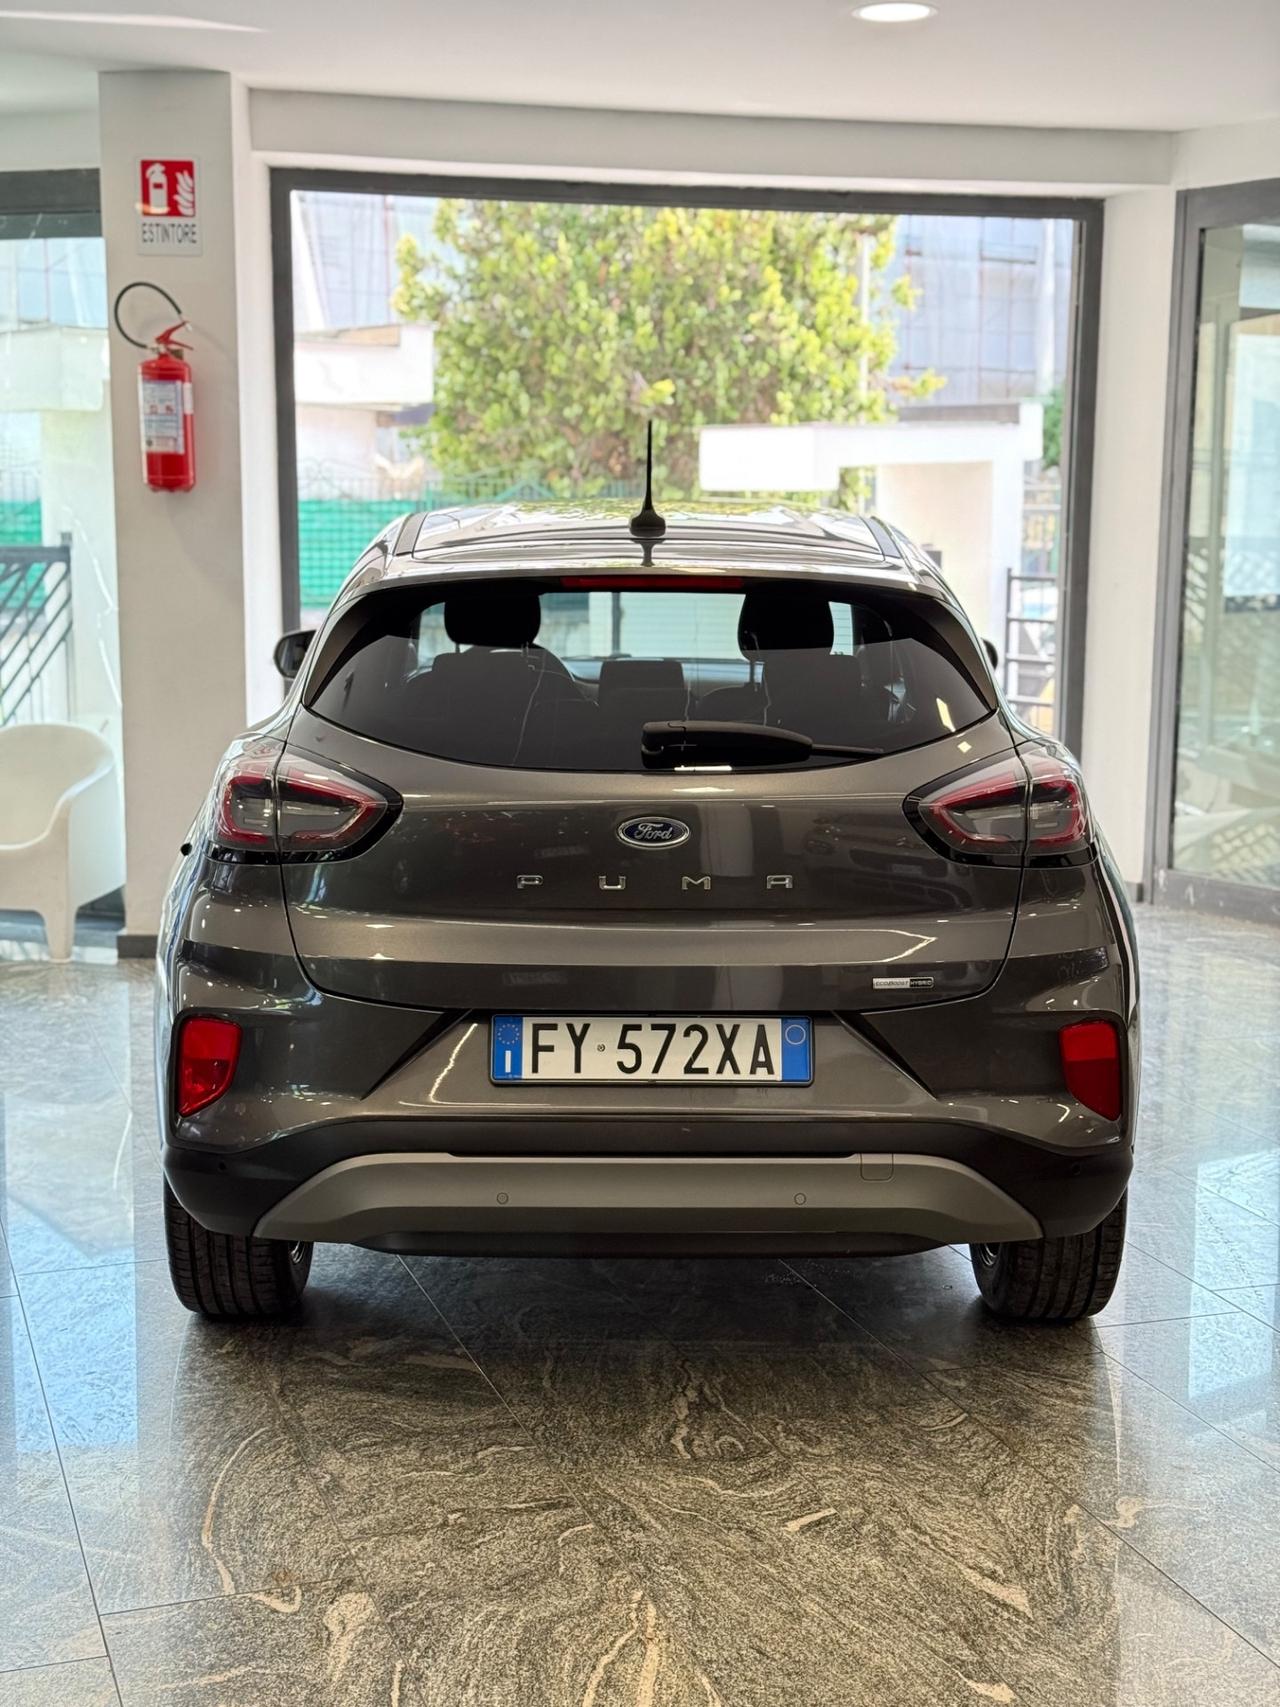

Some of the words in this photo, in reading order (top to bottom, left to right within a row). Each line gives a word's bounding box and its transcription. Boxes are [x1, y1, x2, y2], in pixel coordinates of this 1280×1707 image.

[142, 222, 197, 244] ESTINTORE
[634, 822, 673, 840] Ford
[516, 874, 794, 890] PUMA
[531, 1023, 591, 1074] FY
[616, 1023, 775, 1075] 572XA
